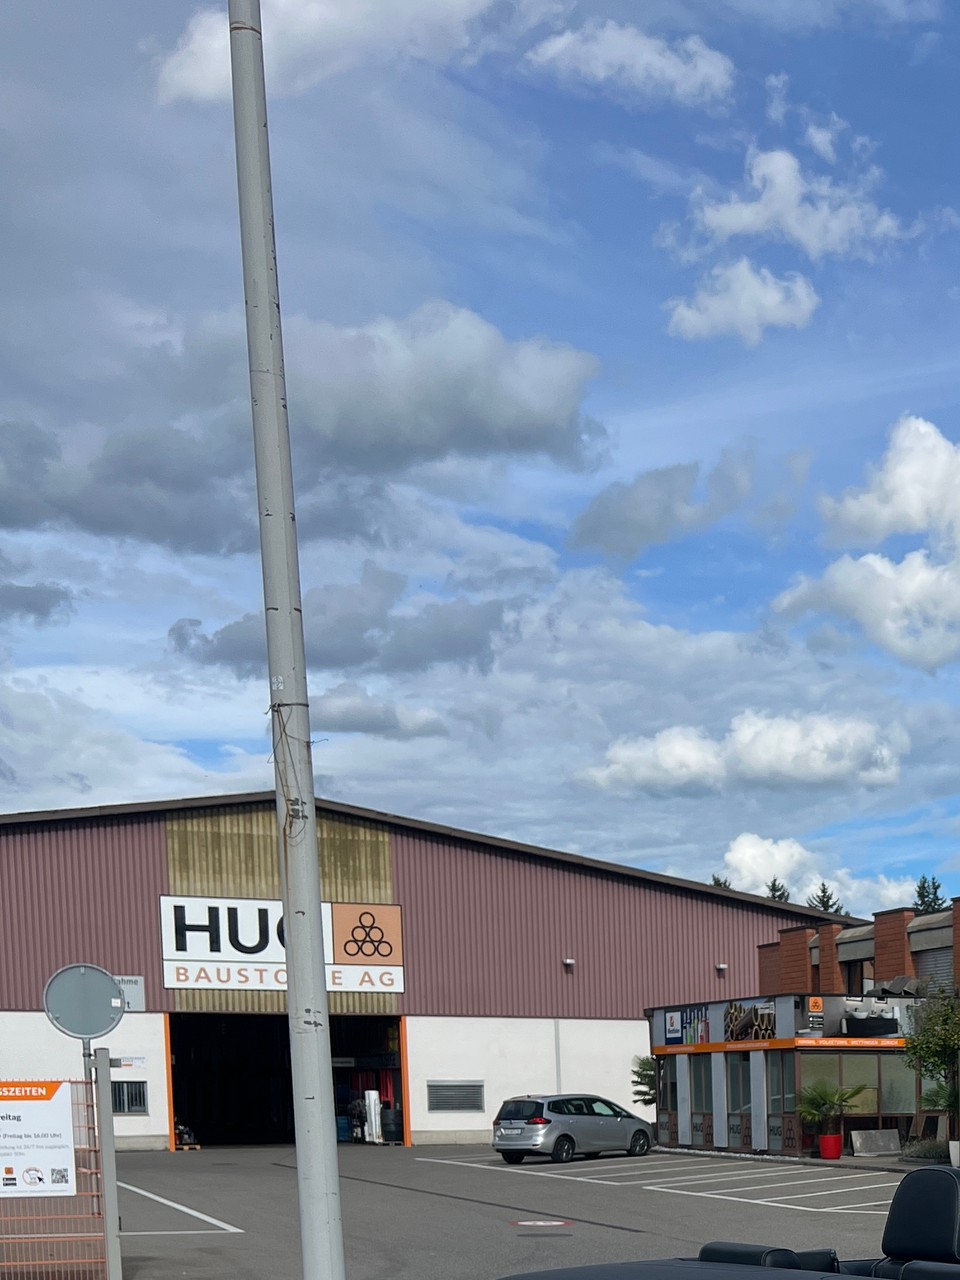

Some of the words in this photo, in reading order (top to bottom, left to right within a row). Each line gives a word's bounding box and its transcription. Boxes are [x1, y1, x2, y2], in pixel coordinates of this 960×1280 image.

[174, 905, 286, 954] HU
[175, 966, 343, 986] BAUSTOE
[358, 971, 395, 987] AG
[770, 1125, 783, 1136] HUG
